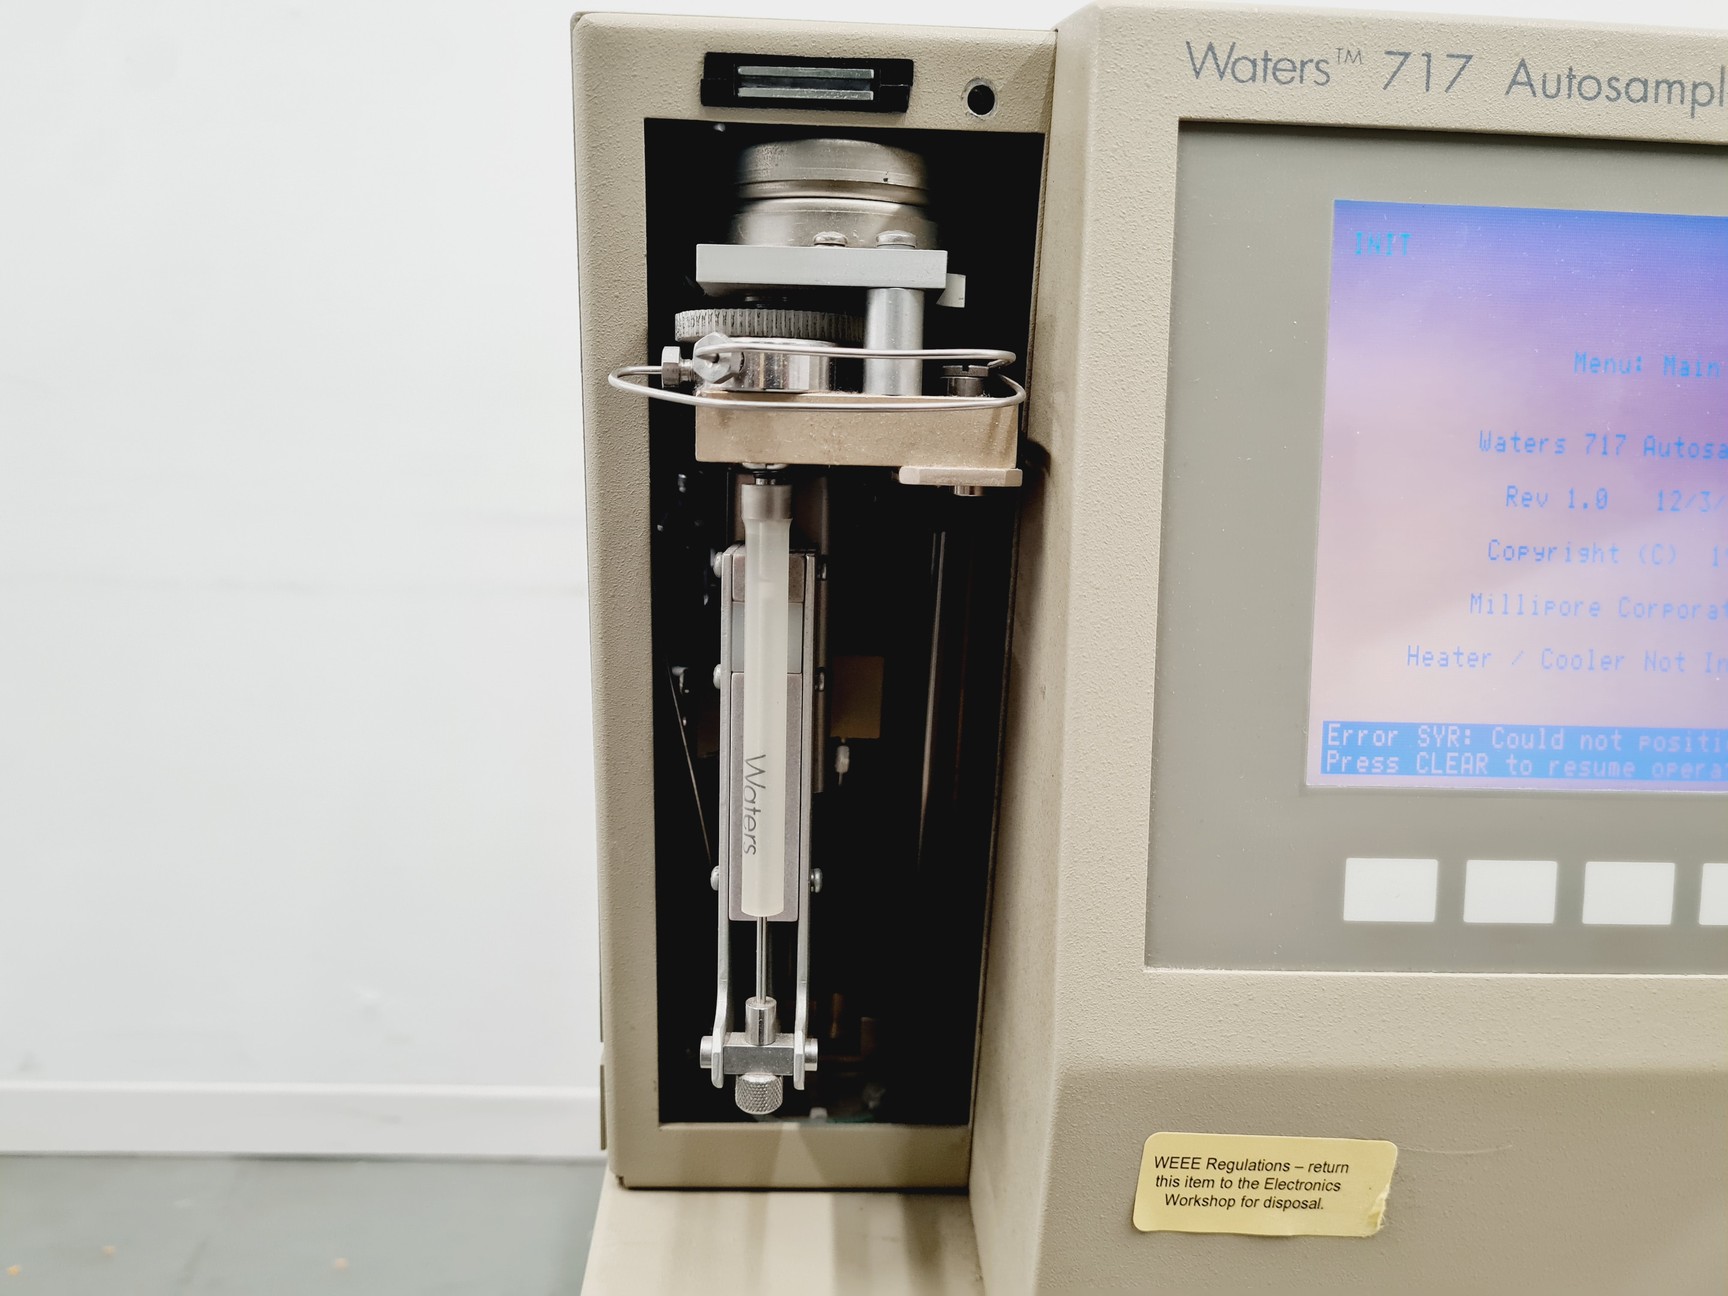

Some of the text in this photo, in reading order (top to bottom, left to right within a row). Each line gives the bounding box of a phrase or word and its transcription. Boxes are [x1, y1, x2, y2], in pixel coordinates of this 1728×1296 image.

[1382, 50, 1474, 94] 717
[1505, 57, 1726, 119] Autosampl
[1355, 231, 1412, 257] INIT
[1574, 351, 1720, 378] Menu: Main
[1479, 430, 1567, 455] Waters
[1585, 433, 1627, 457] 717
[1505, 485, 1549, 509] Rev
[1567, 487, 1609, 511] 1.0
[1487, 539, 1728, 568] Copyright (C) 1
[1469, 592, 1601, 618] Millipore
[1406, 645, 1492, 668] Heater
[1510, 650, 1524, 667] /
[1540, 648, 1625, 671] Cooler
[1644, 651, 1686, 673] Not
[1327, 723, 1399, 747] Error
[1417, 725, 1472, 748] SYR:
[1491, 727, 1565, 751] Could
[1580, 731, 1622, 751] not
[1326, 750, 1400, 774] Press
[1416, 752, 1489, 776] CLEAR
[1505, 753, 1533, 776] to
[1548, 757, 1635, 777] resume
[744, 754, 766, 855] Waters
[1154, 1156, 1202, 1170] WEEE
[1206, 1157, 1290, 1174] Regulations
[1308, 1161, 1349, 1174] return
[1155, 1175, 1341, 1192] this item to the Electronics
[1164, 1193, 1325, 1212] Workshop for disposal.
